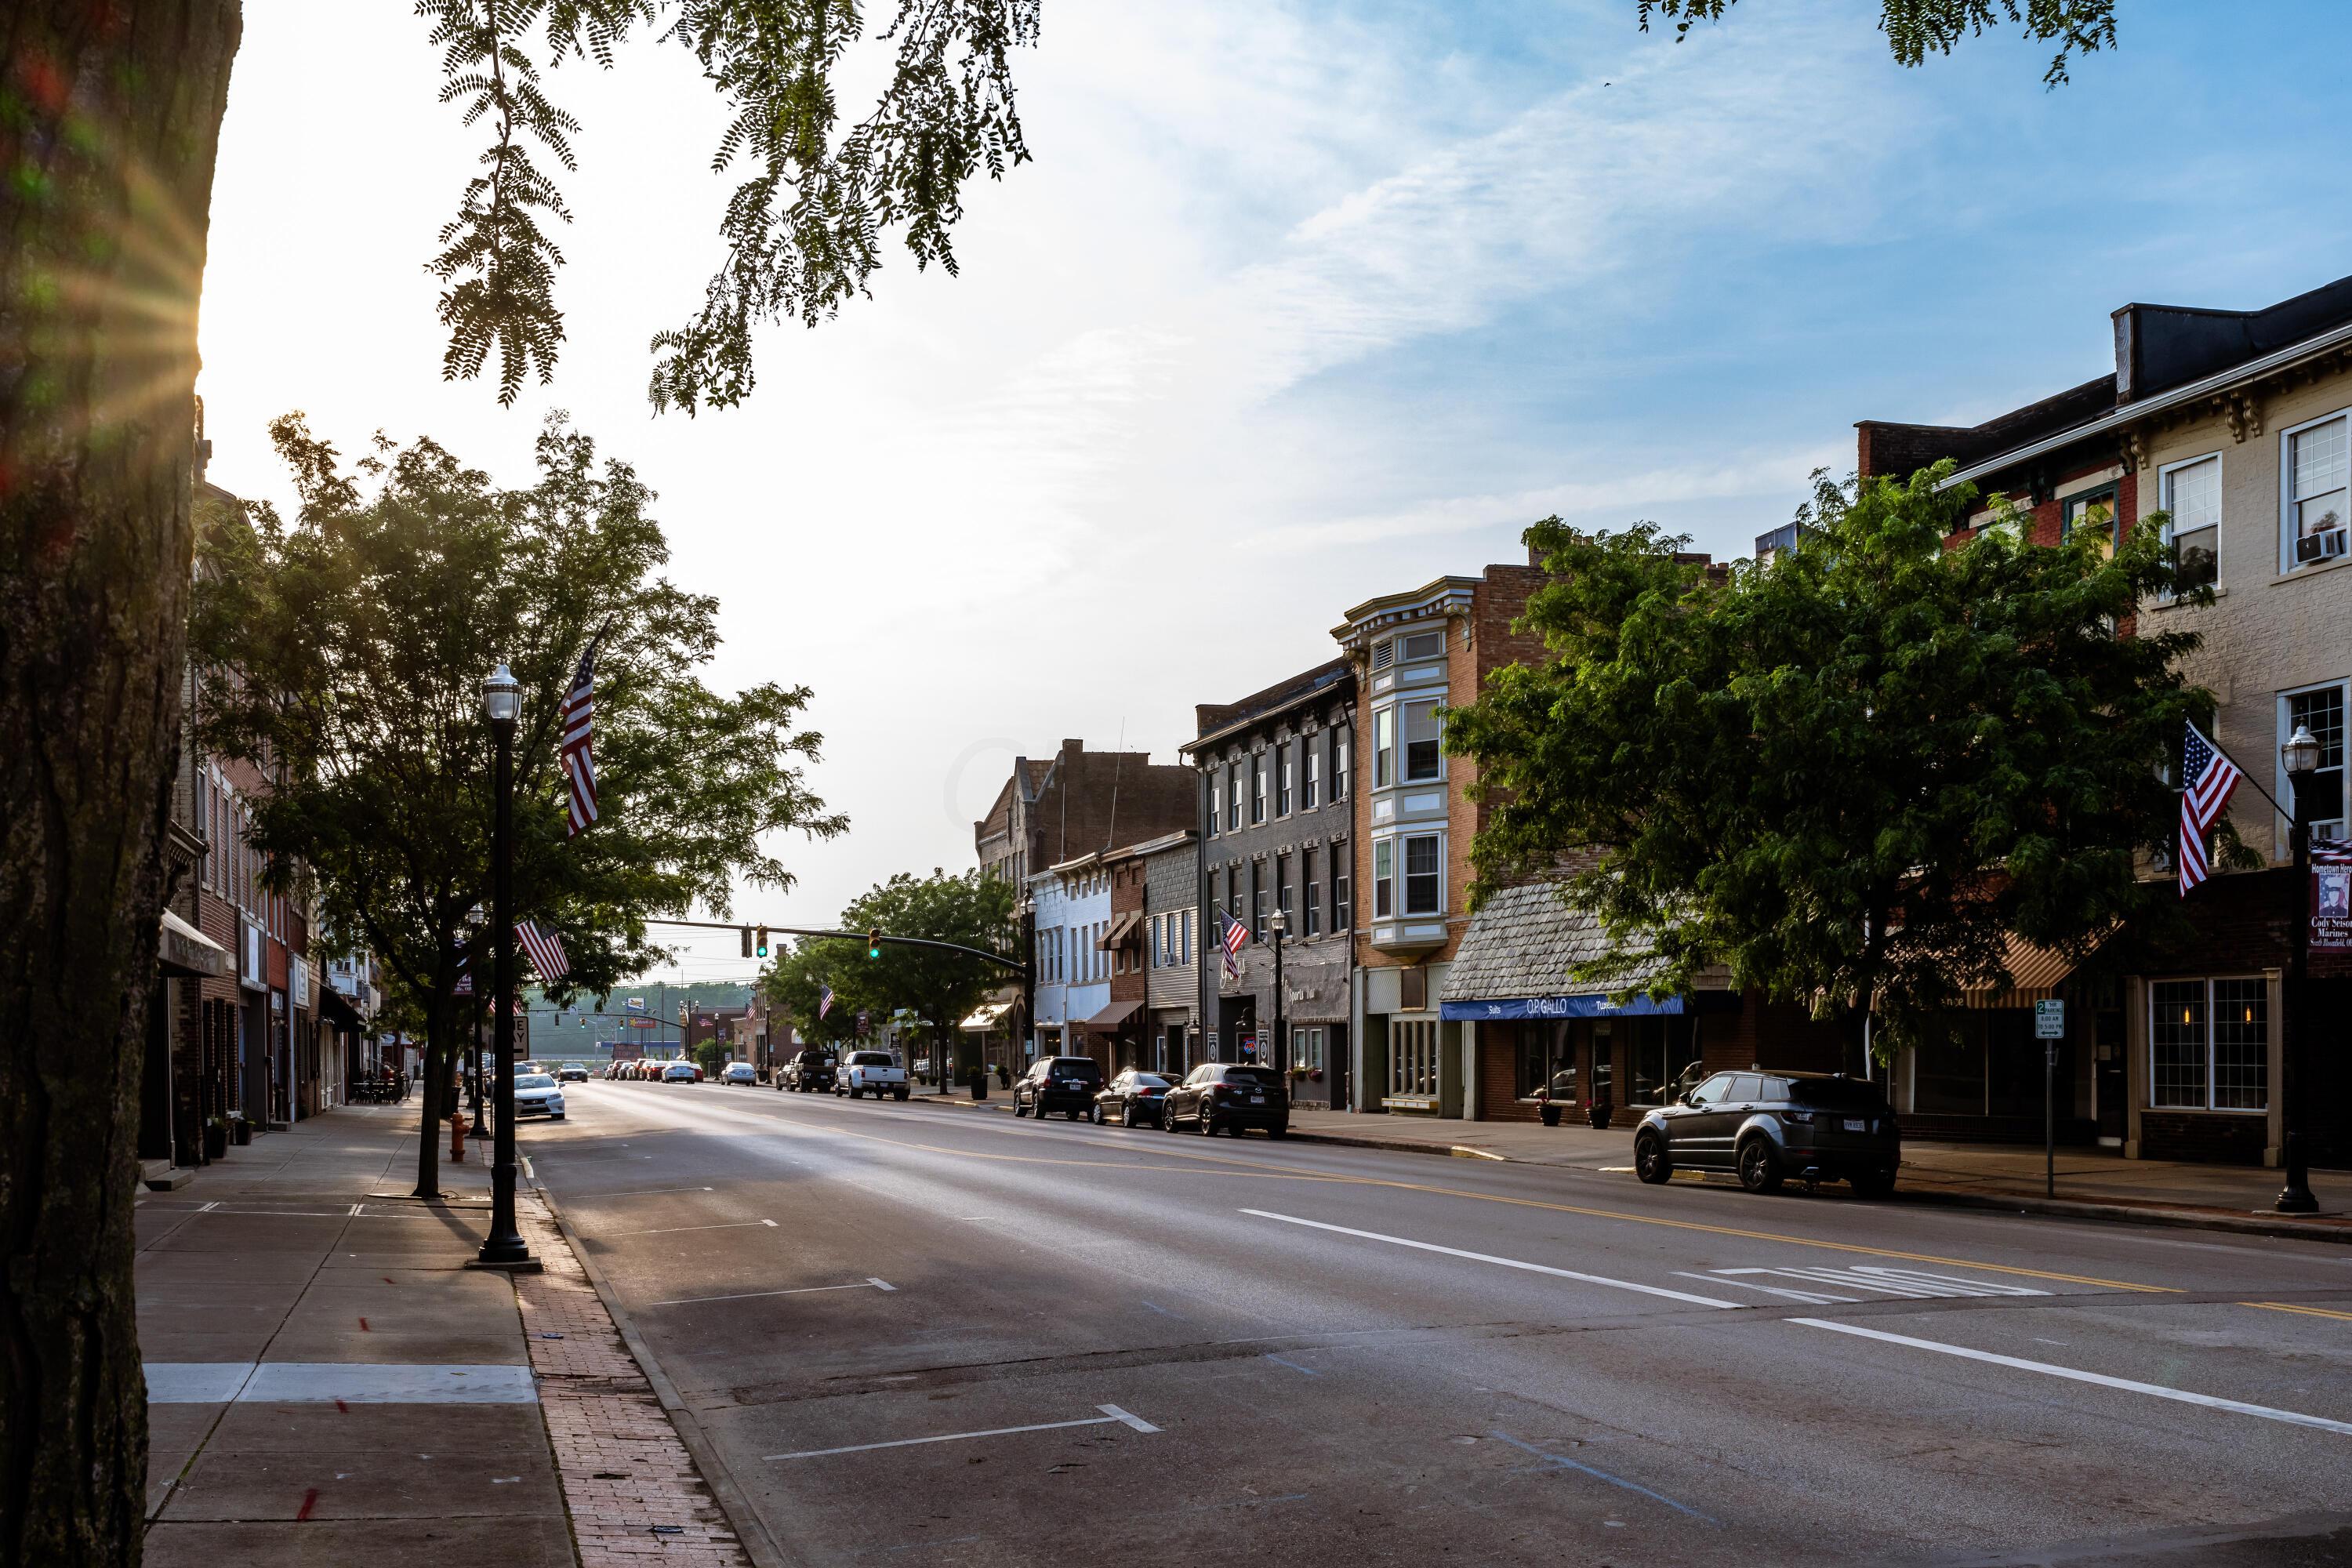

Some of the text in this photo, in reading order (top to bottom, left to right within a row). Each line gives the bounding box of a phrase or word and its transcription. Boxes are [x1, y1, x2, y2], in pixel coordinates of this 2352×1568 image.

[2311, 863, 2339, 873] Hometown
[2311, 916, 2330, 927] Cody
[2318, 928, 2348, 937] Marines
[1288, 988, 1304, 1005] Sports
[1489, 1005, 1501, 1014] Suits
[1541, 998, 1566, 1014] GALLO
[2038, 1003, 2044, 1013] 2
